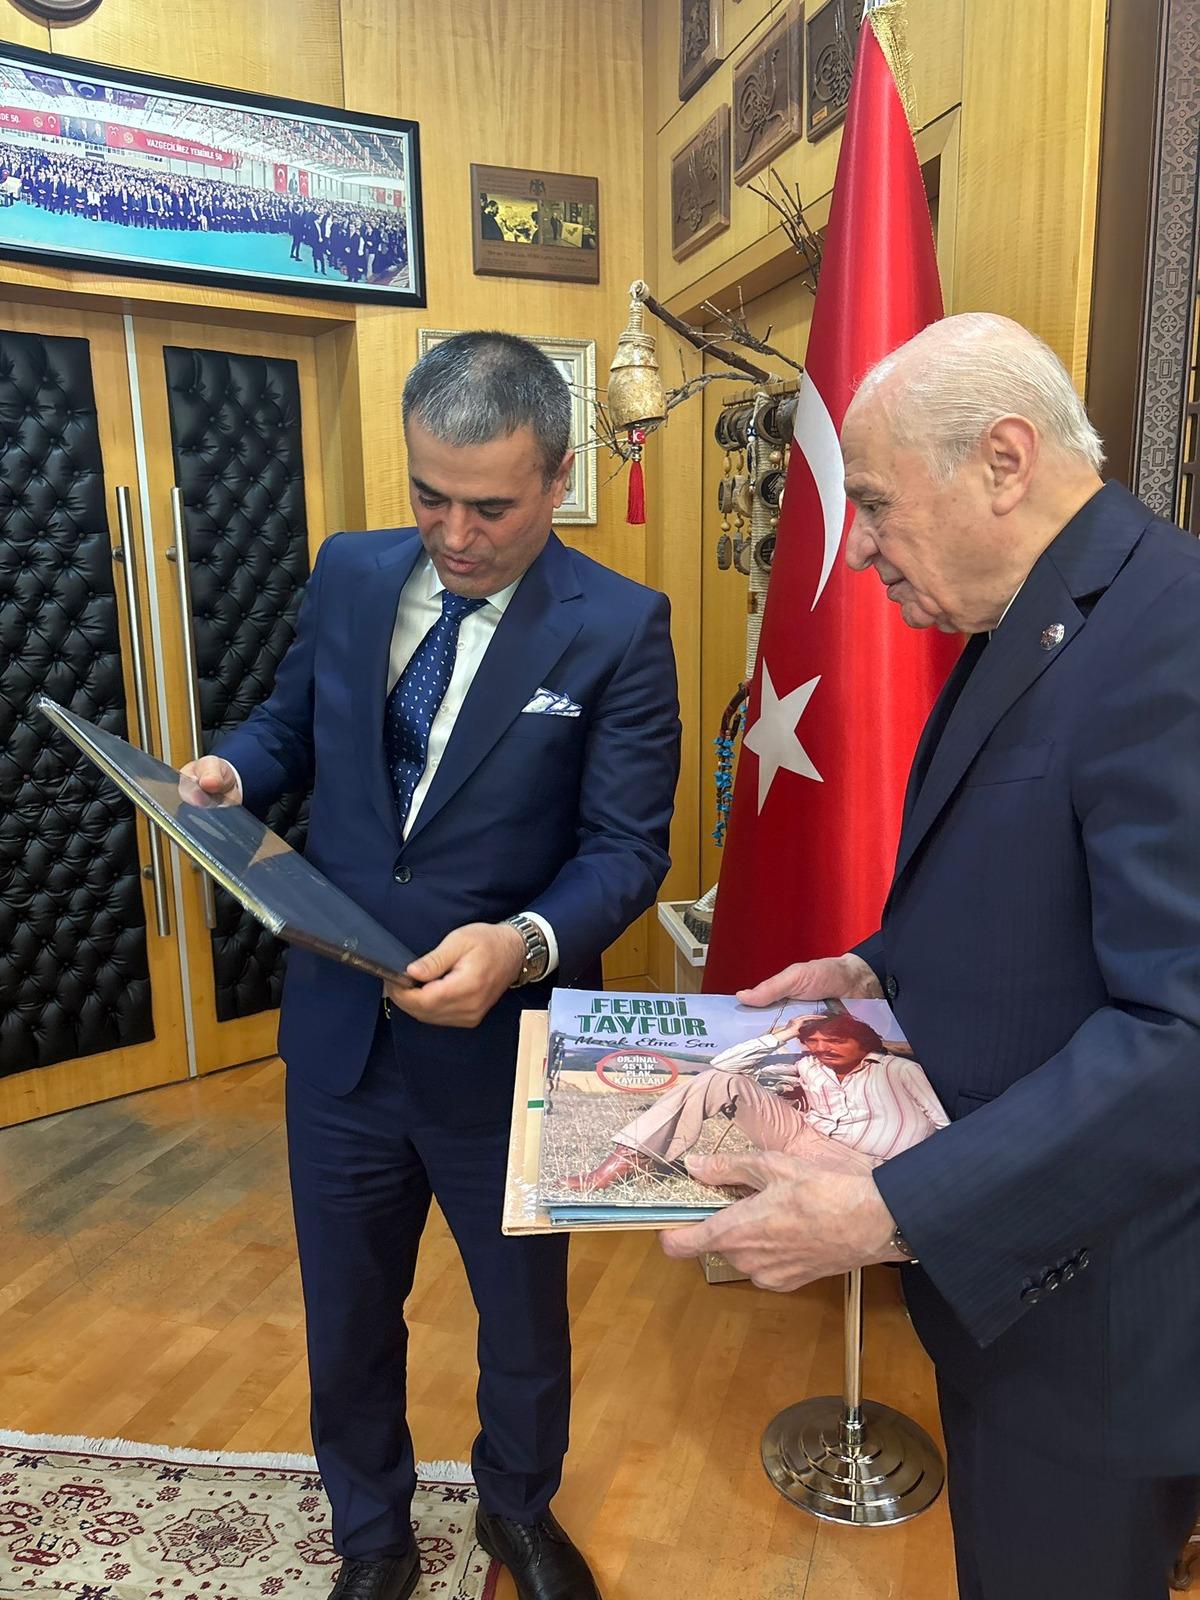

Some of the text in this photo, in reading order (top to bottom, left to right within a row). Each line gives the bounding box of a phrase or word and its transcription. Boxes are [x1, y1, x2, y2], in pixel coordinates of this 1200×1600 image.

[0, 112, 10, 122] DE
[591, 997, 687, 1016] FERDİ
[575, 1014, 707, 1036] TAYFUR
[635, 1037, 679, 1047] Etme
[685, 1038, 718, 1049] Sen
[626, 1070, 651, 1078] PLAK
